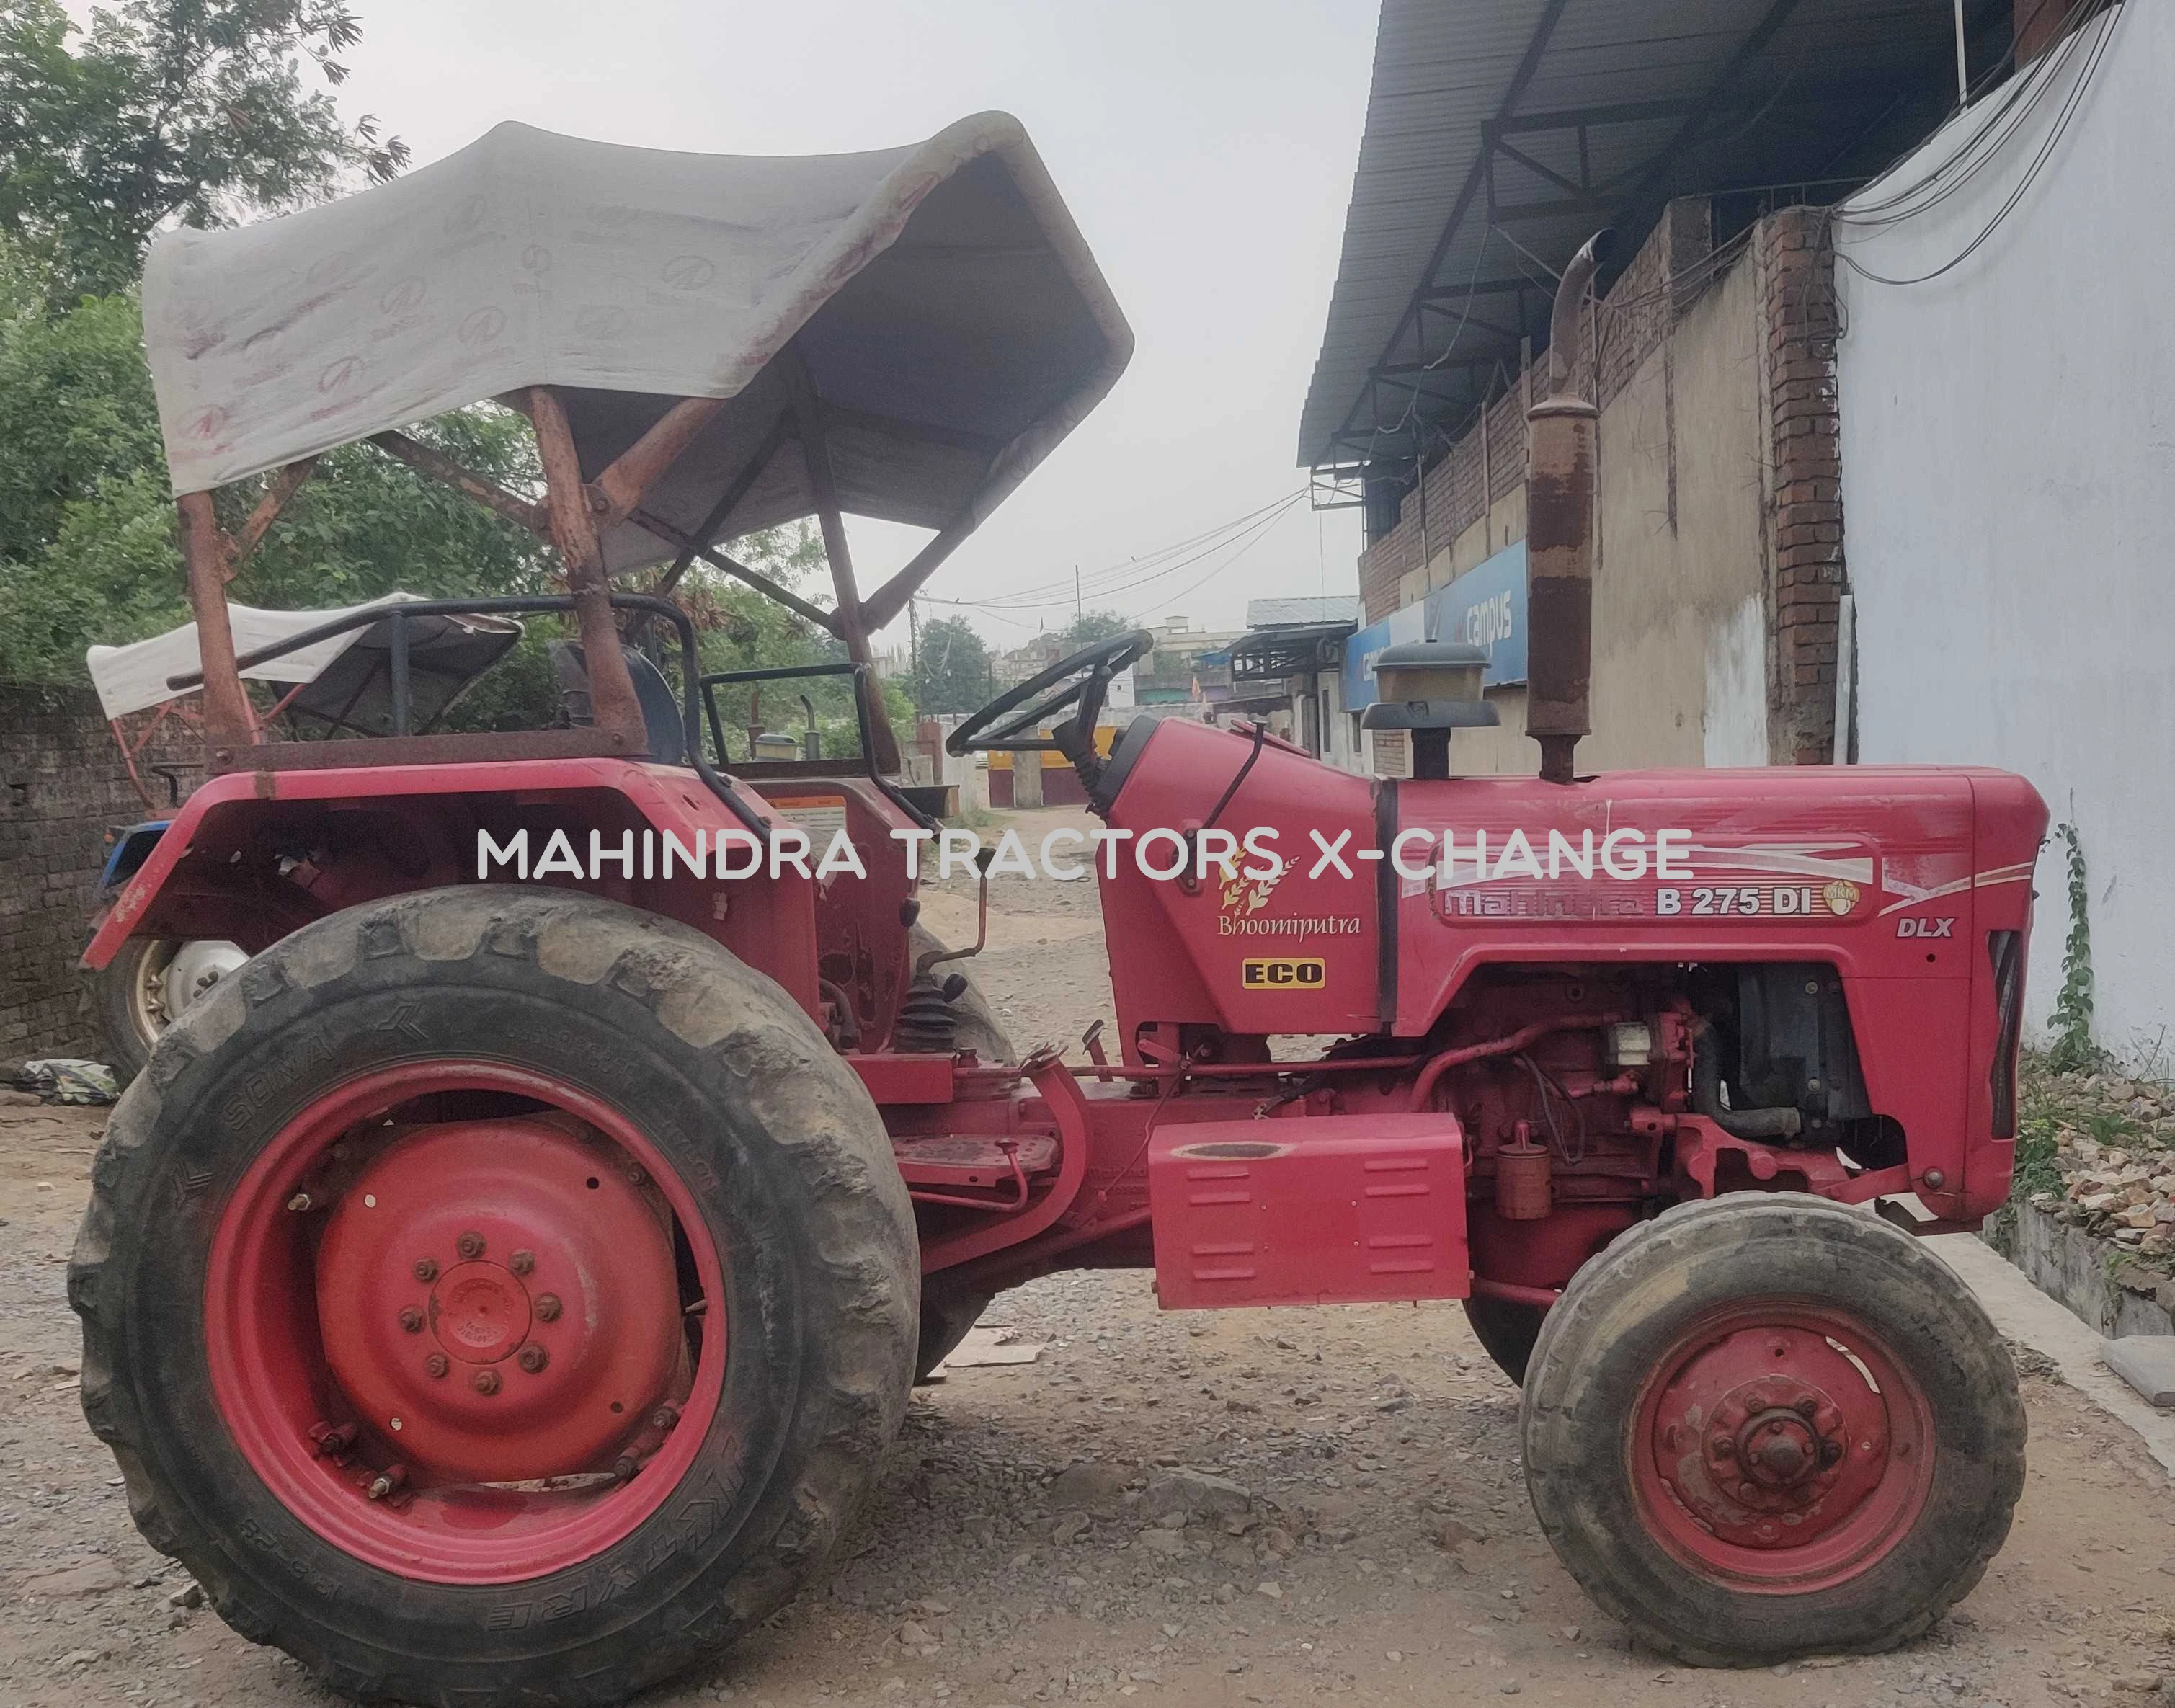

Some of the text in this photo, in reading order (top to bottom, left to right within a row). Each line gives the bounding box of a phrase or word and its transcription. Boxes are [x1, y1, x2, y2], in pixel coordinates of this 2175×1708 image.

[1656, 888, 1681, 915] B
[1691, 888, 1761, 915] 275
[1772, 887, 1811, 915] DI
[1826, 887, 1857, 900] MKM
[1217, 911, 1361, 943] Bhoomiputra
[1896, 917, 1955, 938] DLX
[1245, 963, 1323, 984] ECO
[223, 1035, 335, 1131] SONA
